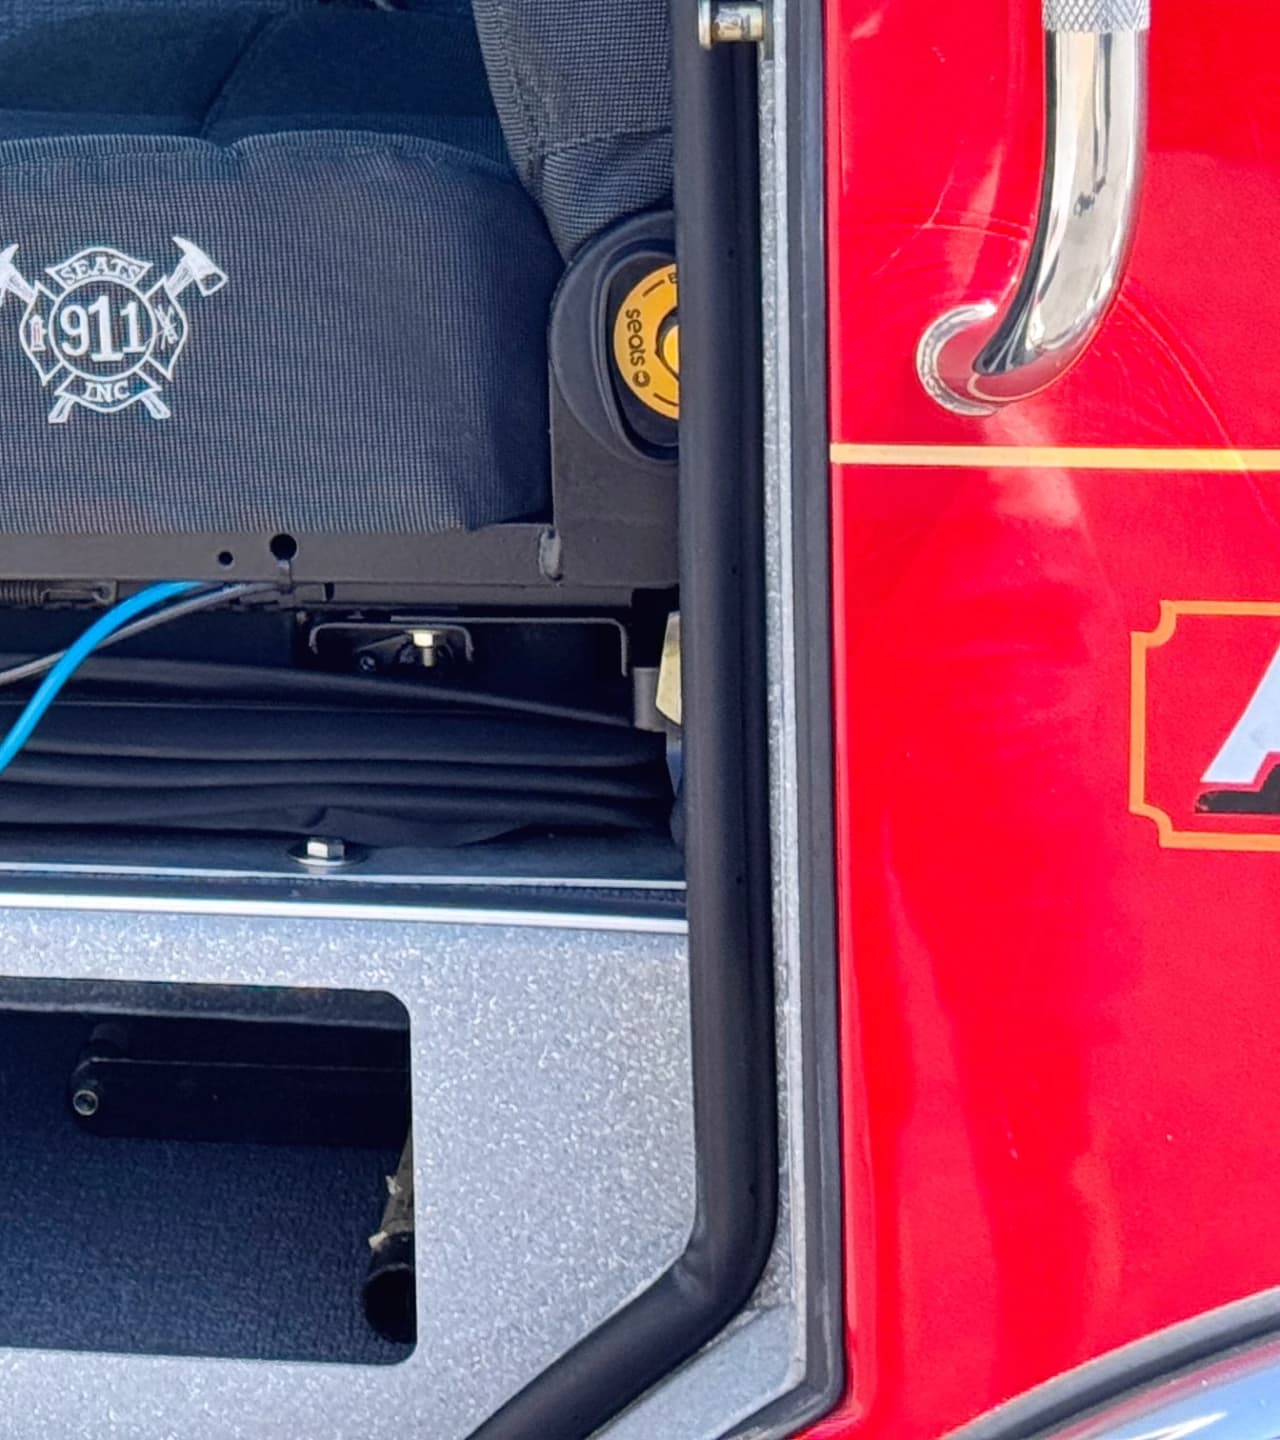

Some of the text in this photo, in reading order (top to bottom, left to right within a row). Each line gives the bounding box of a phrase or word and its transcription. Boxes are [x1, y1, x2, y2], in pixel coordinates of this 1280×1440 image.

[59, 256, 141, 286] SEATS
[60, 295, 148, 362] 911
[626, 307, 647, 367] seats
[81, 381, 131, 403] INC
